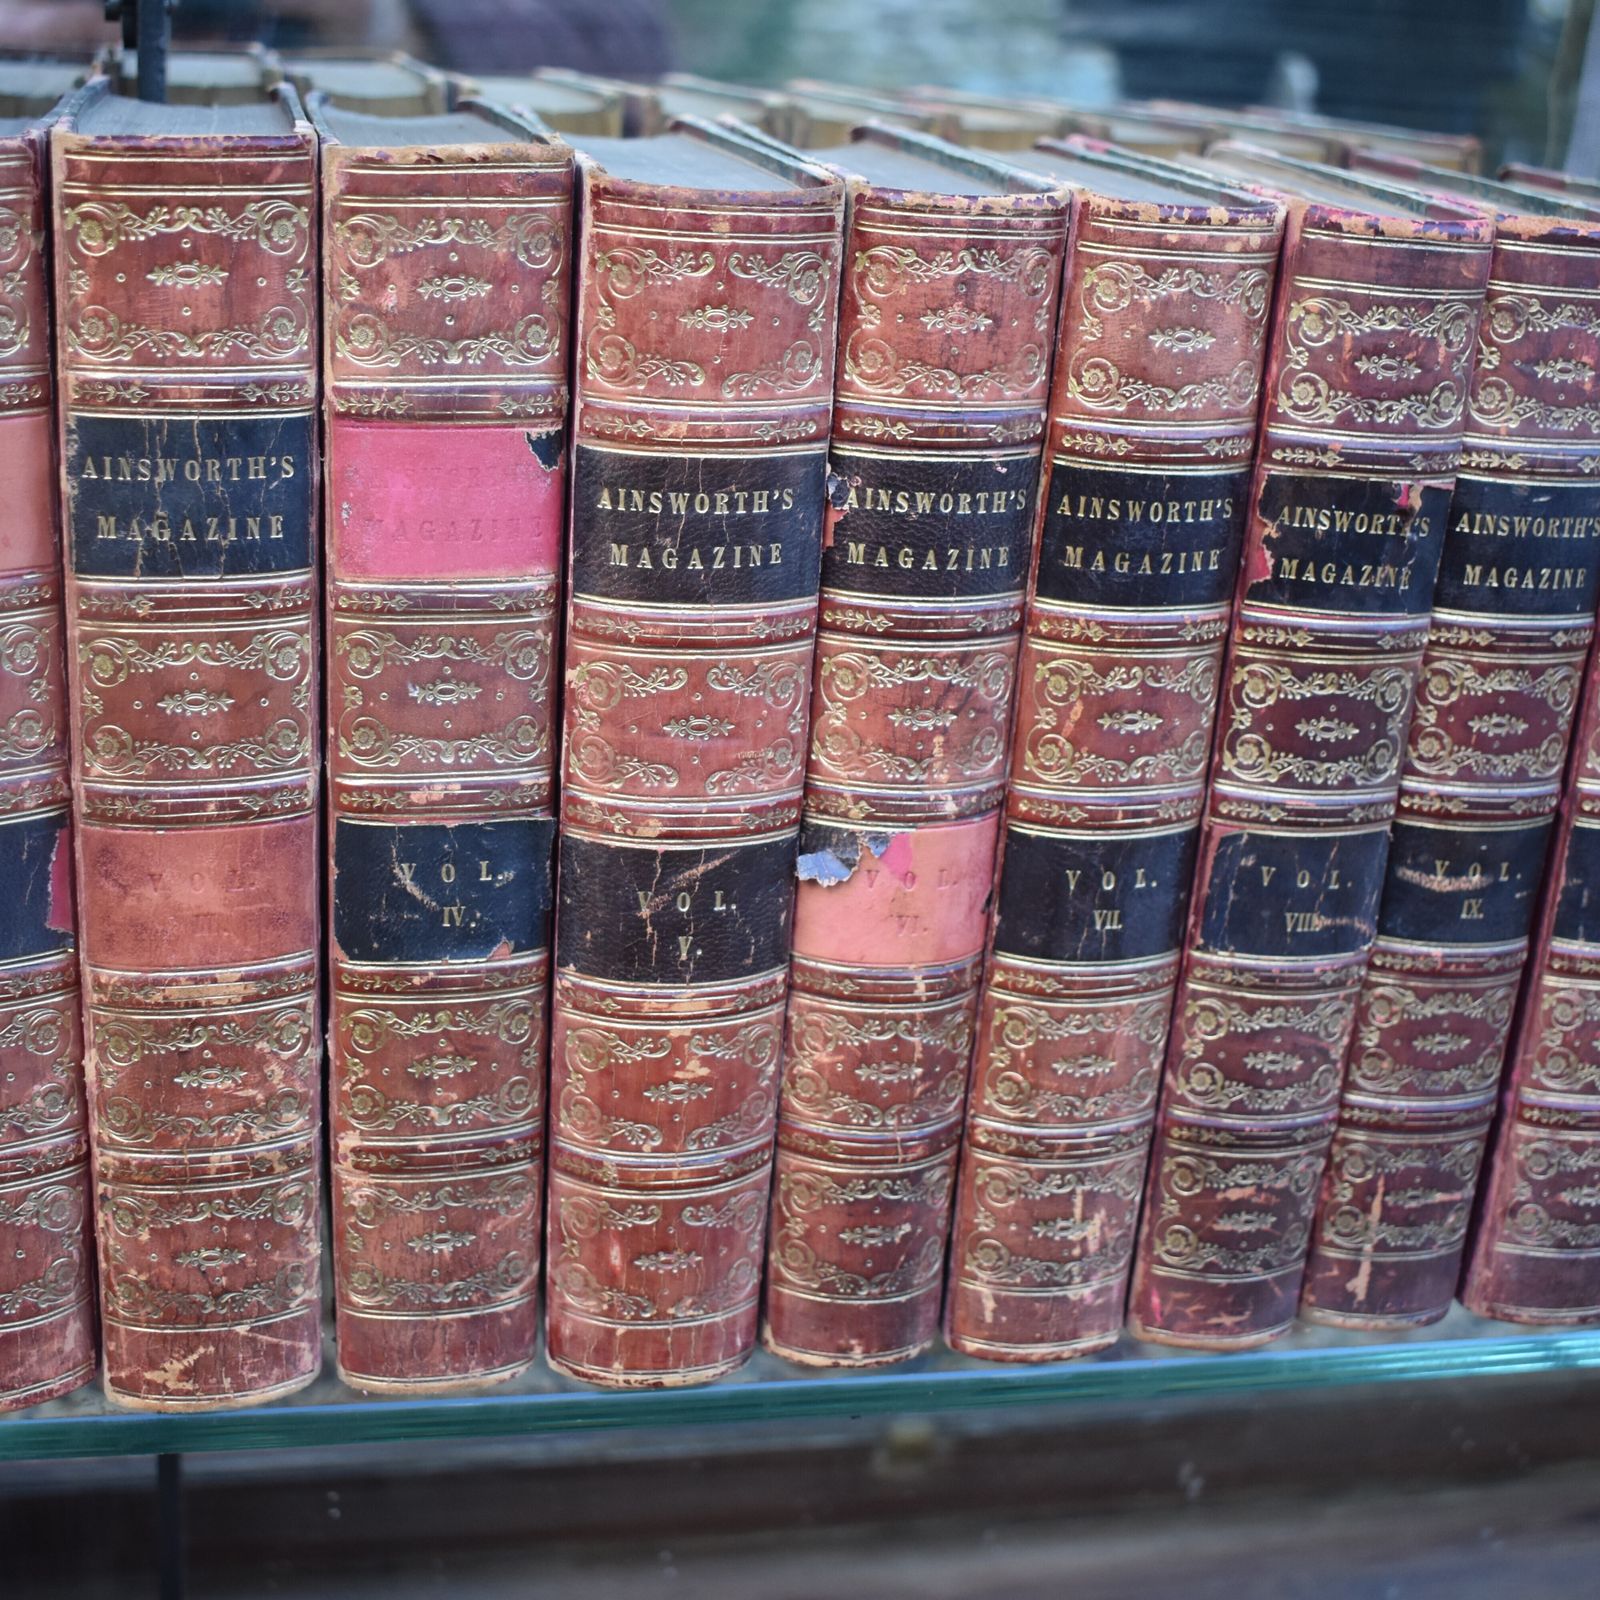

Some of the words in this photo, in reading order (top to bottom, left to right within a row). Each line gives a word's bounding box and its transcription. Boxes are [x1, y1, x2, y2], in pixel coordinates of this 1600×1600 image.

[81, 456, 295, 481] AINSWORTH'S
[597, 487, 794, 515] AINSWORTH'S
[846, 487, 1027, 515] AINSWORTH'S
[1056, 494, 1233, 523] AINSWORTH'S
[97, 515, 284, 541] MAGAZINE
[610, 543, 782, 570] MAGAZINE
[847, 542, 1010, 571] MAGAZINE
[1063, 545, 1221, 574] MAGAZINE
[1279, 557, 1412, 590] MAGAZINE
[1463, 564, 1587, 590] MAGAZINE
[1065, 868, 1158, 891] VOL.
[1261, 865, 1353, 890] VOL.
[442, 905, 476, 928] IV.
[1093, 909, 1123, 931] VII.
[678, 936, 702, 960] V.
